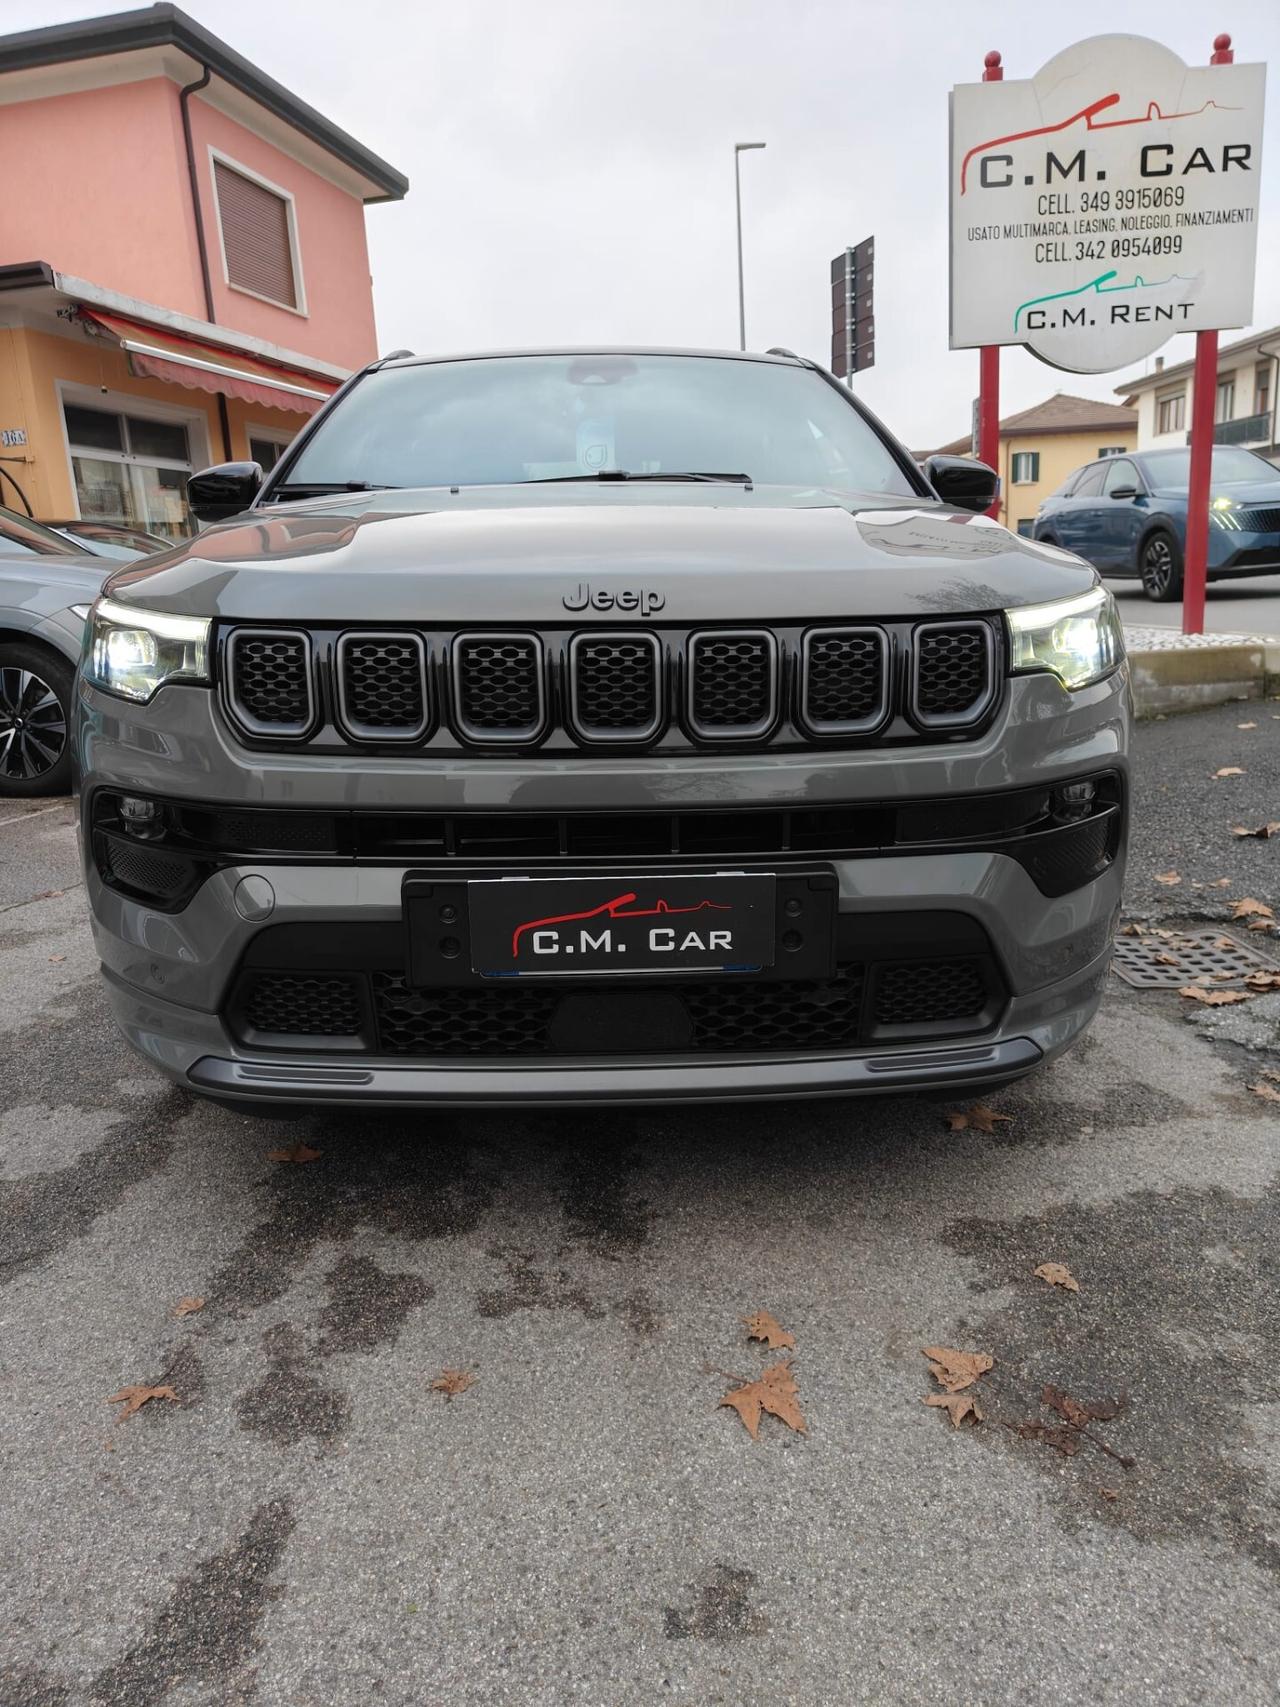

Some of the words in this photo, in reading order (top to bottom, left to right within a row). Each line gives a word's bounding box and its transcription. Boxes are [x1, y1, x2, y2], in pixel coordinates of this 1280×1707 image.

[980, 149, 1106, 188] C.M.
[1140, 144, 1252, 177] CAR
[1038, 193, 1075, 215] CELL.
[1080, 190, 1110, 212] 349
[1115, 186, 1185, 211] 3915069
[967, 225, 1000, 241] USATO
[1175, 208, 1254, 228] FINANZIAMENTI
[1035, 242, 1072, 263] CELL.
[1075, 240, 1105, 260] 342
[1111, 234, 1183, 258] 0954099
[1027, 307, 1096, 329] C.M.
[1110, 303, 1195, 324] RENT
[562, 582, 666, 617] Jeep
[532, 929, 627, 954] C.M.
[649, 928, 733, 951] CAR
